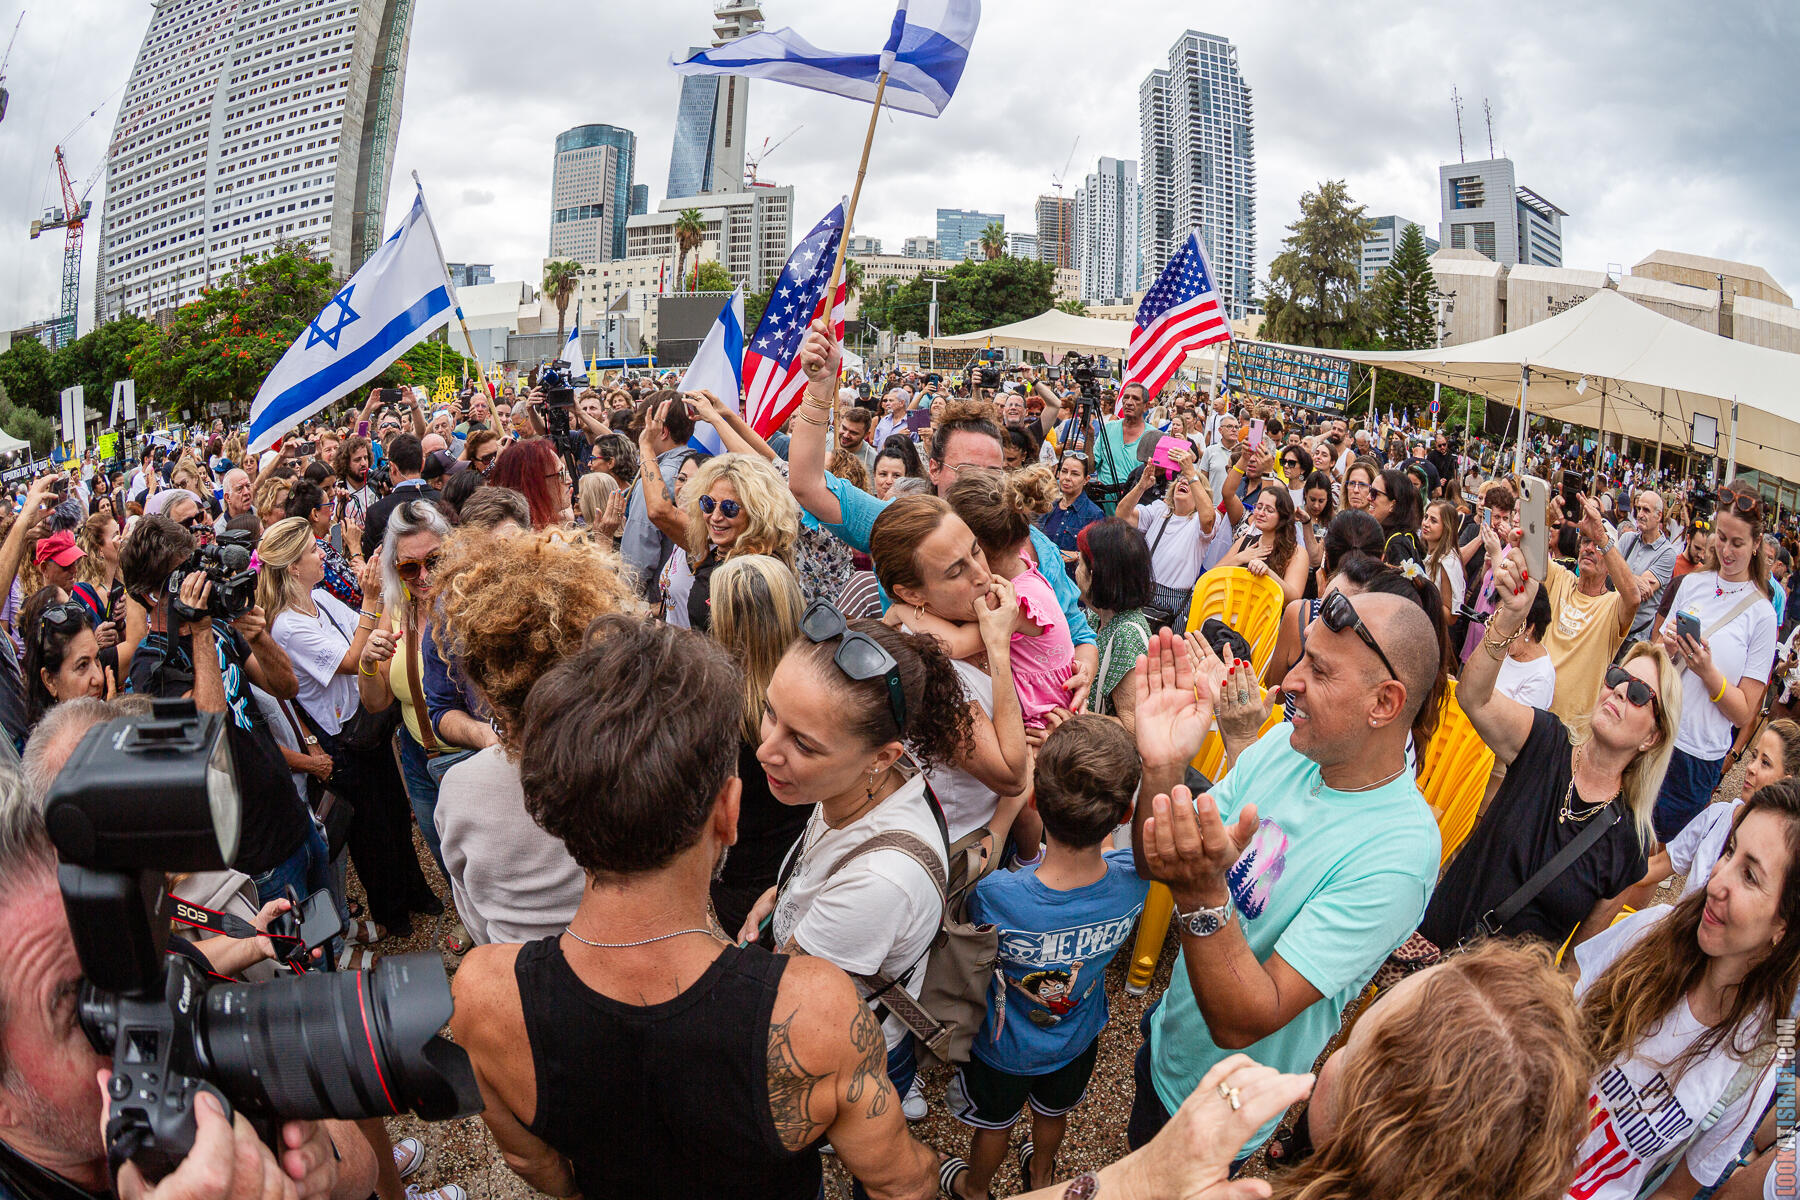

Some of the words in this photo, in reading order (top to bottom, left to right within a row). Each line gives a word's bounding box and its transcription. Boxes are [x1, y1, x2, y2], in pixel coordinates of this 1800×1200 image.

[436, 374, 456, 384] YOU
[439, 382, 456, 392] ARE
[177, 904, 208, 923] EOS
[1074, 911, 1136, 958] PIEC
[1597, 1064, 1643, 1129] הביתה
[1638, 1071, 1693, 1139] מחזירים
[1624, 1116, 1669, 1158] אותם
